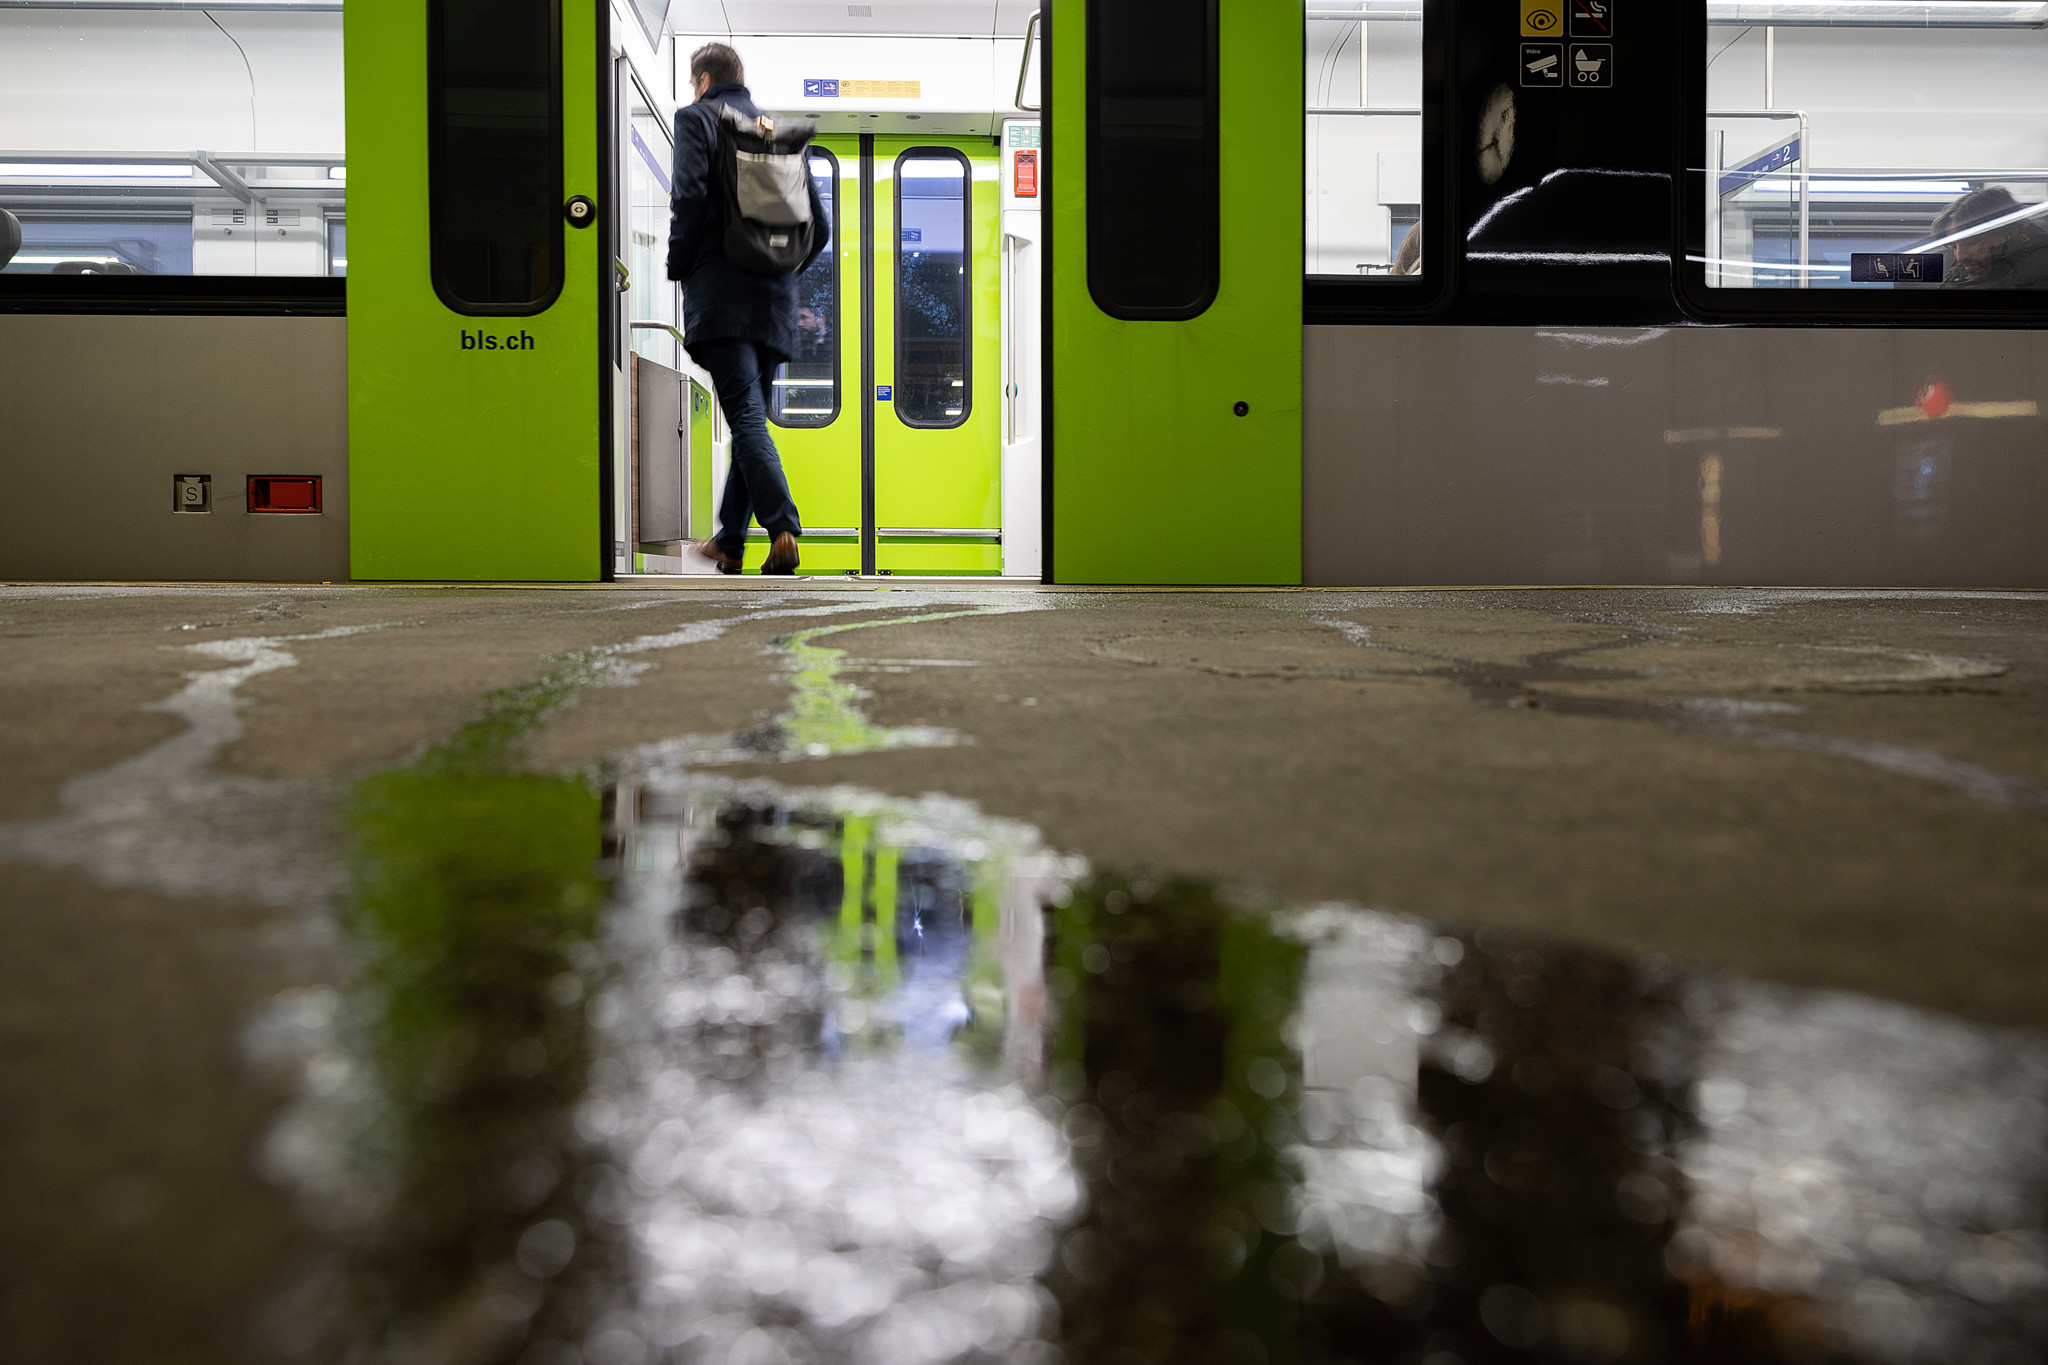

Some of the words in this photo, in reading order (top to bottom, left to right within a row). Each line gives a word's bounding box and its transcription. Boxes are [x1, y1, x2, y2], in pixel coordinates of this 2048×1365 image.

[1782, 145, 1791, 162] 2
[461, 330, 534, 350] bls.ch
[186, 486, 198, 502] S
